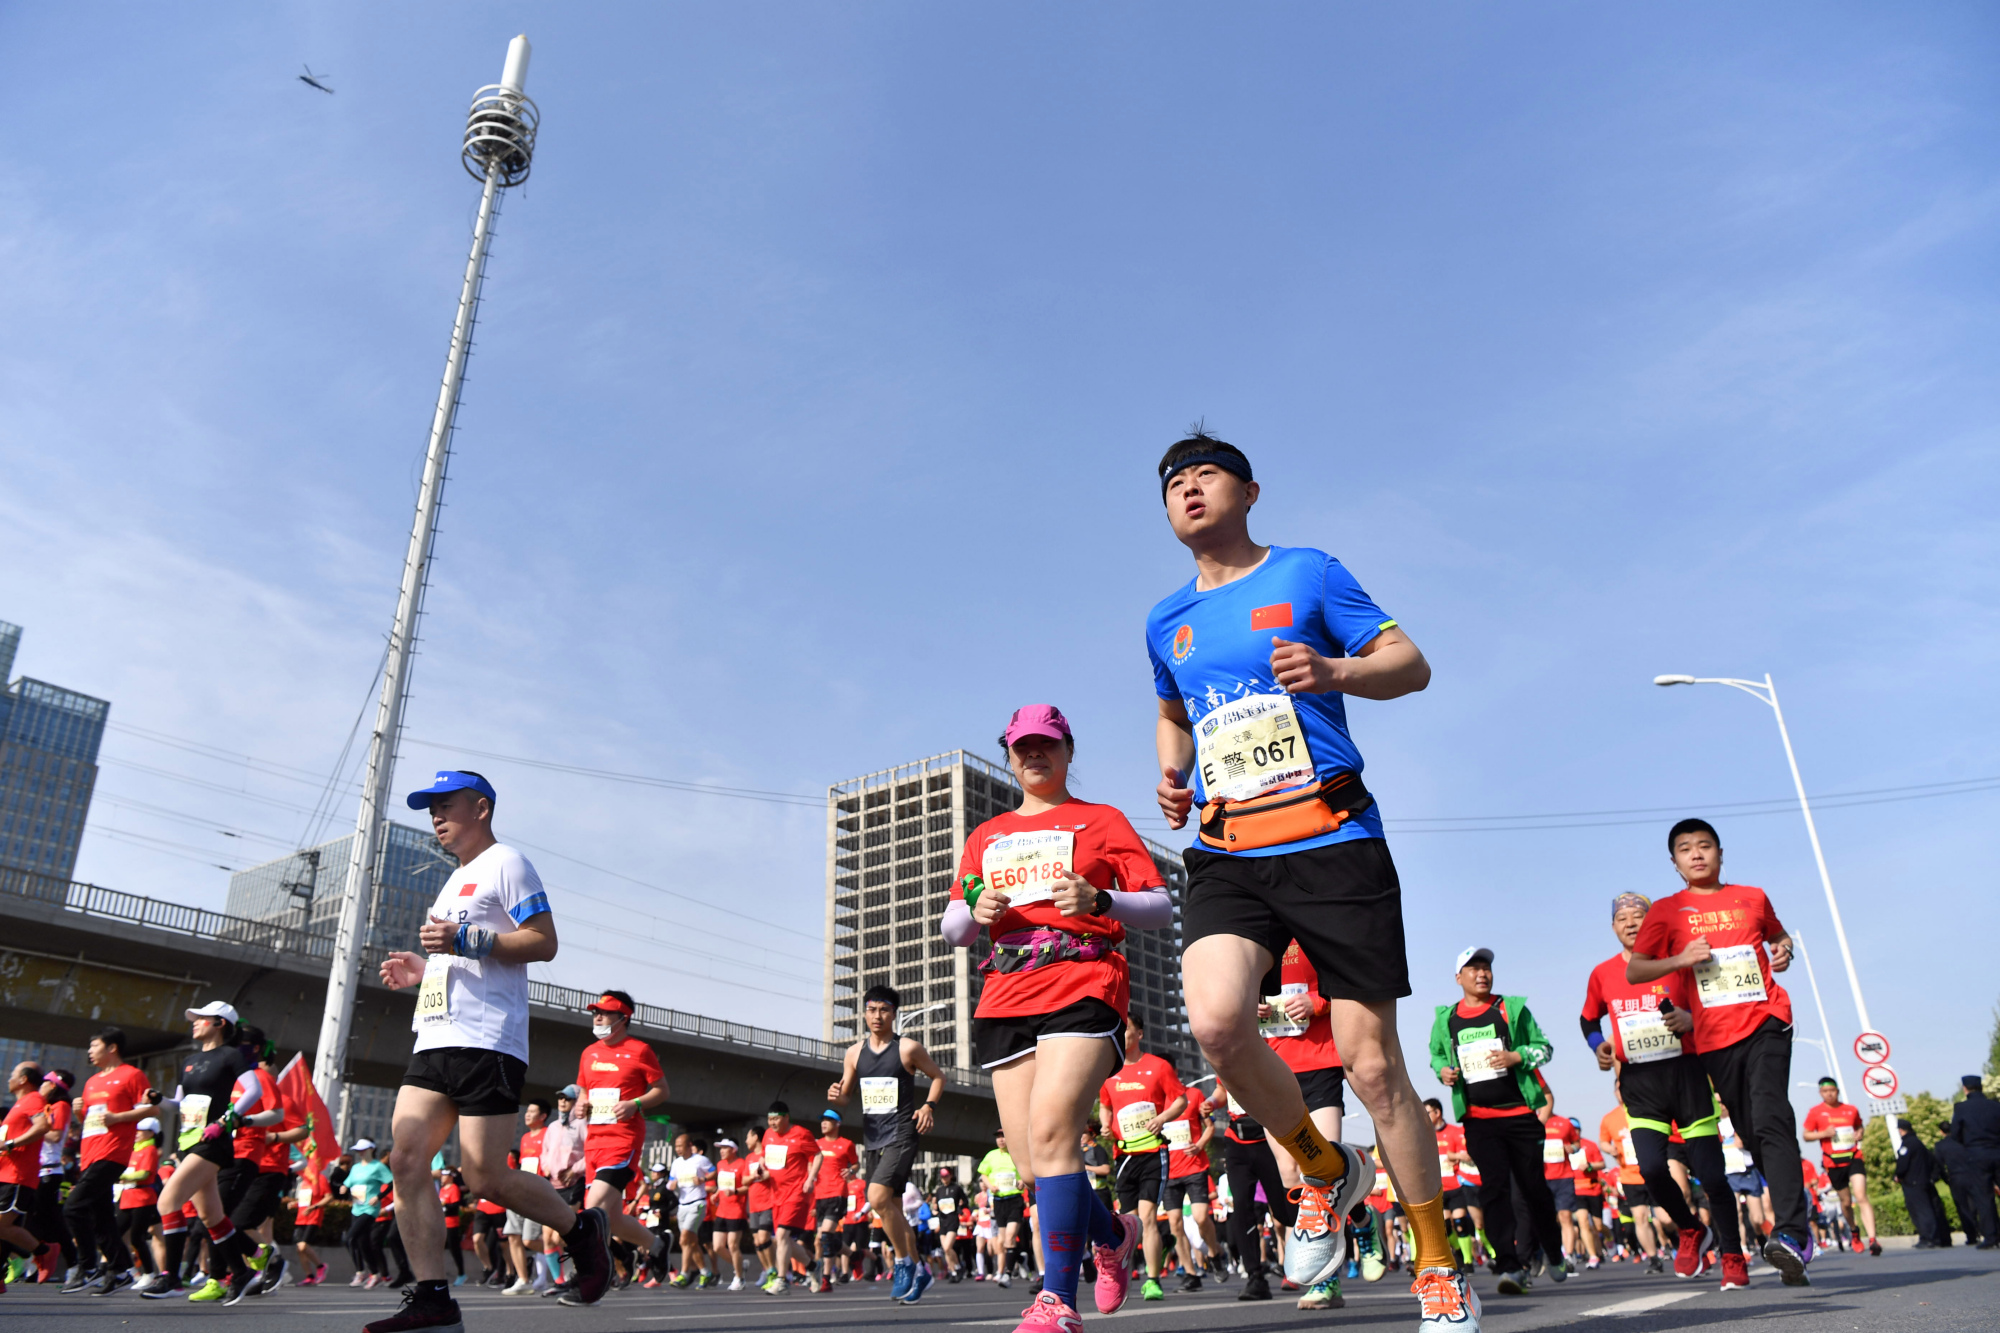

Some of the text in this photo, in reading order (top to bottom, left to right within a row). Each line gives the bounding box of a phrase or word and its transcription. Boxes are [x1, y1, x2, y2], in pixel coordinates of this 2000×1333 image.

[1203, 762, 1217, 787] E
[1221, 751, 1247, 780] 警
[1253, 735, 1296, 767] 067
[990, 861, 1064, 890] E60188
[1690, 924, 1719, 935] CHINA
[1281, 956, 1299, 967] OLICE
[1700, 979, 1711, 992] E
[1734, 973, 1760, 987] 246
[423, 991, 444, 1009] 003
[1611, 994, 1674, 1018] 黎明脚
[1627, 1033, 1675, 1051] E19377
